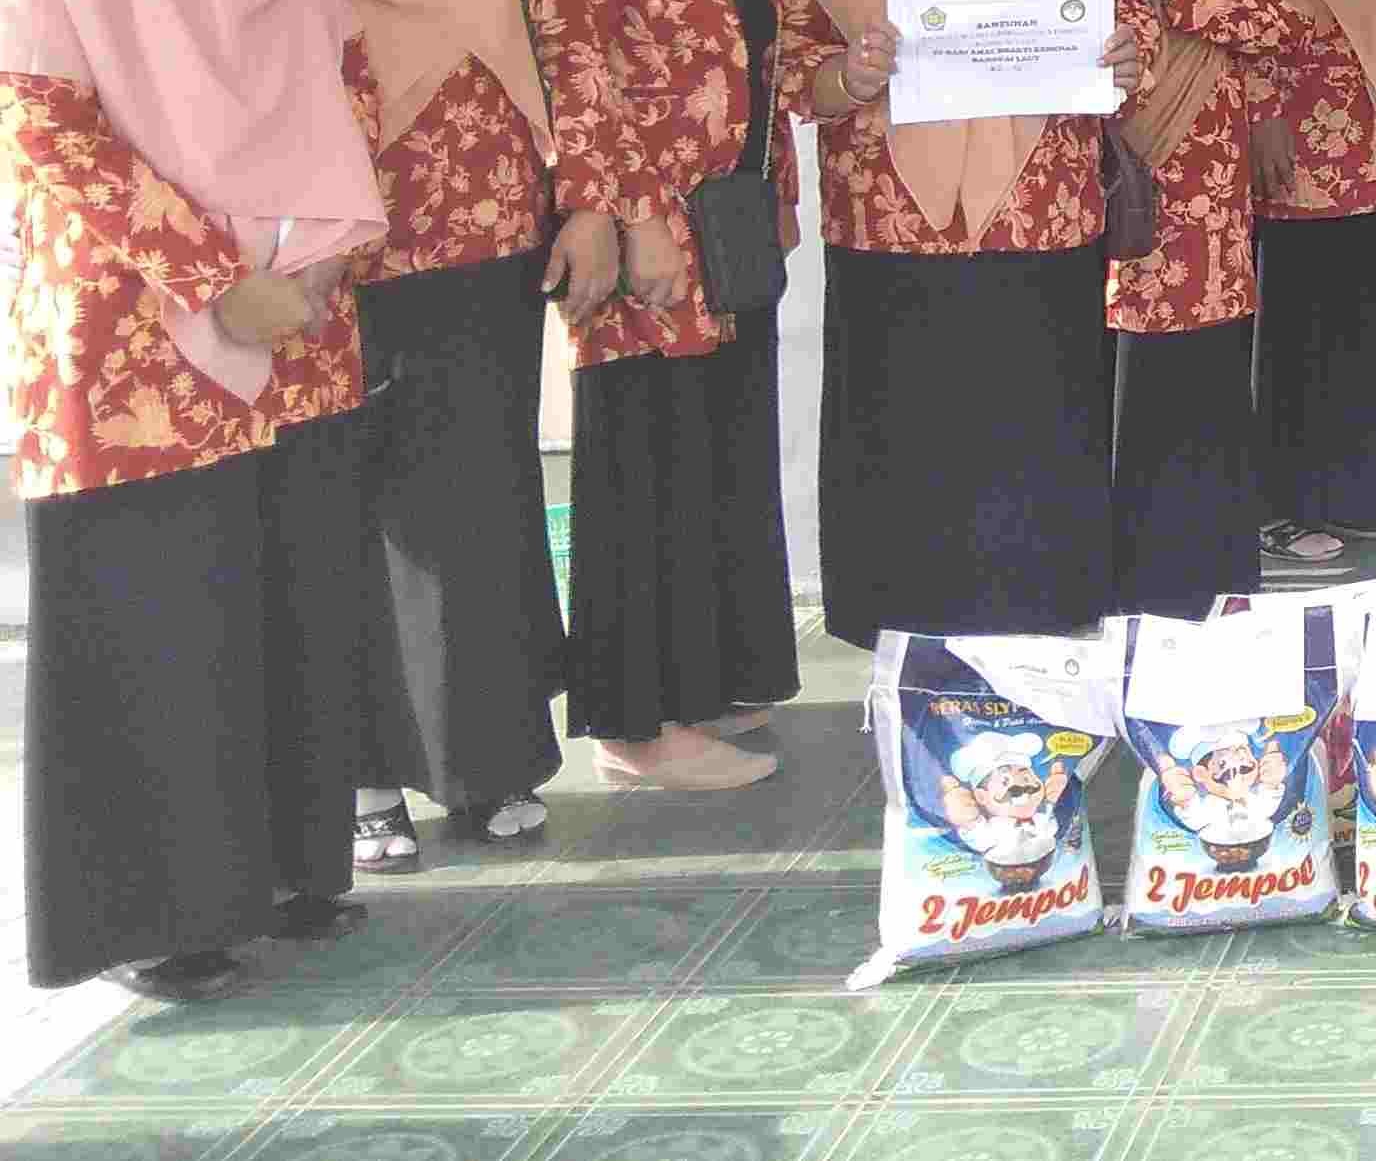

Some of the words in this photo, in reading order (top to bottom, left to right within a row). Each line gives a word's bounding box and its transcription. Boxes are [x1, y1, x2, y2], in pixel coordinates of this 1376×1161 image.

[918, 894, 945, 934] 2
[951, 862, 1090, 941] Jempol
[1147, 865, 1167, 902] 2
[1172, 854, 1316, 913] Jempol
